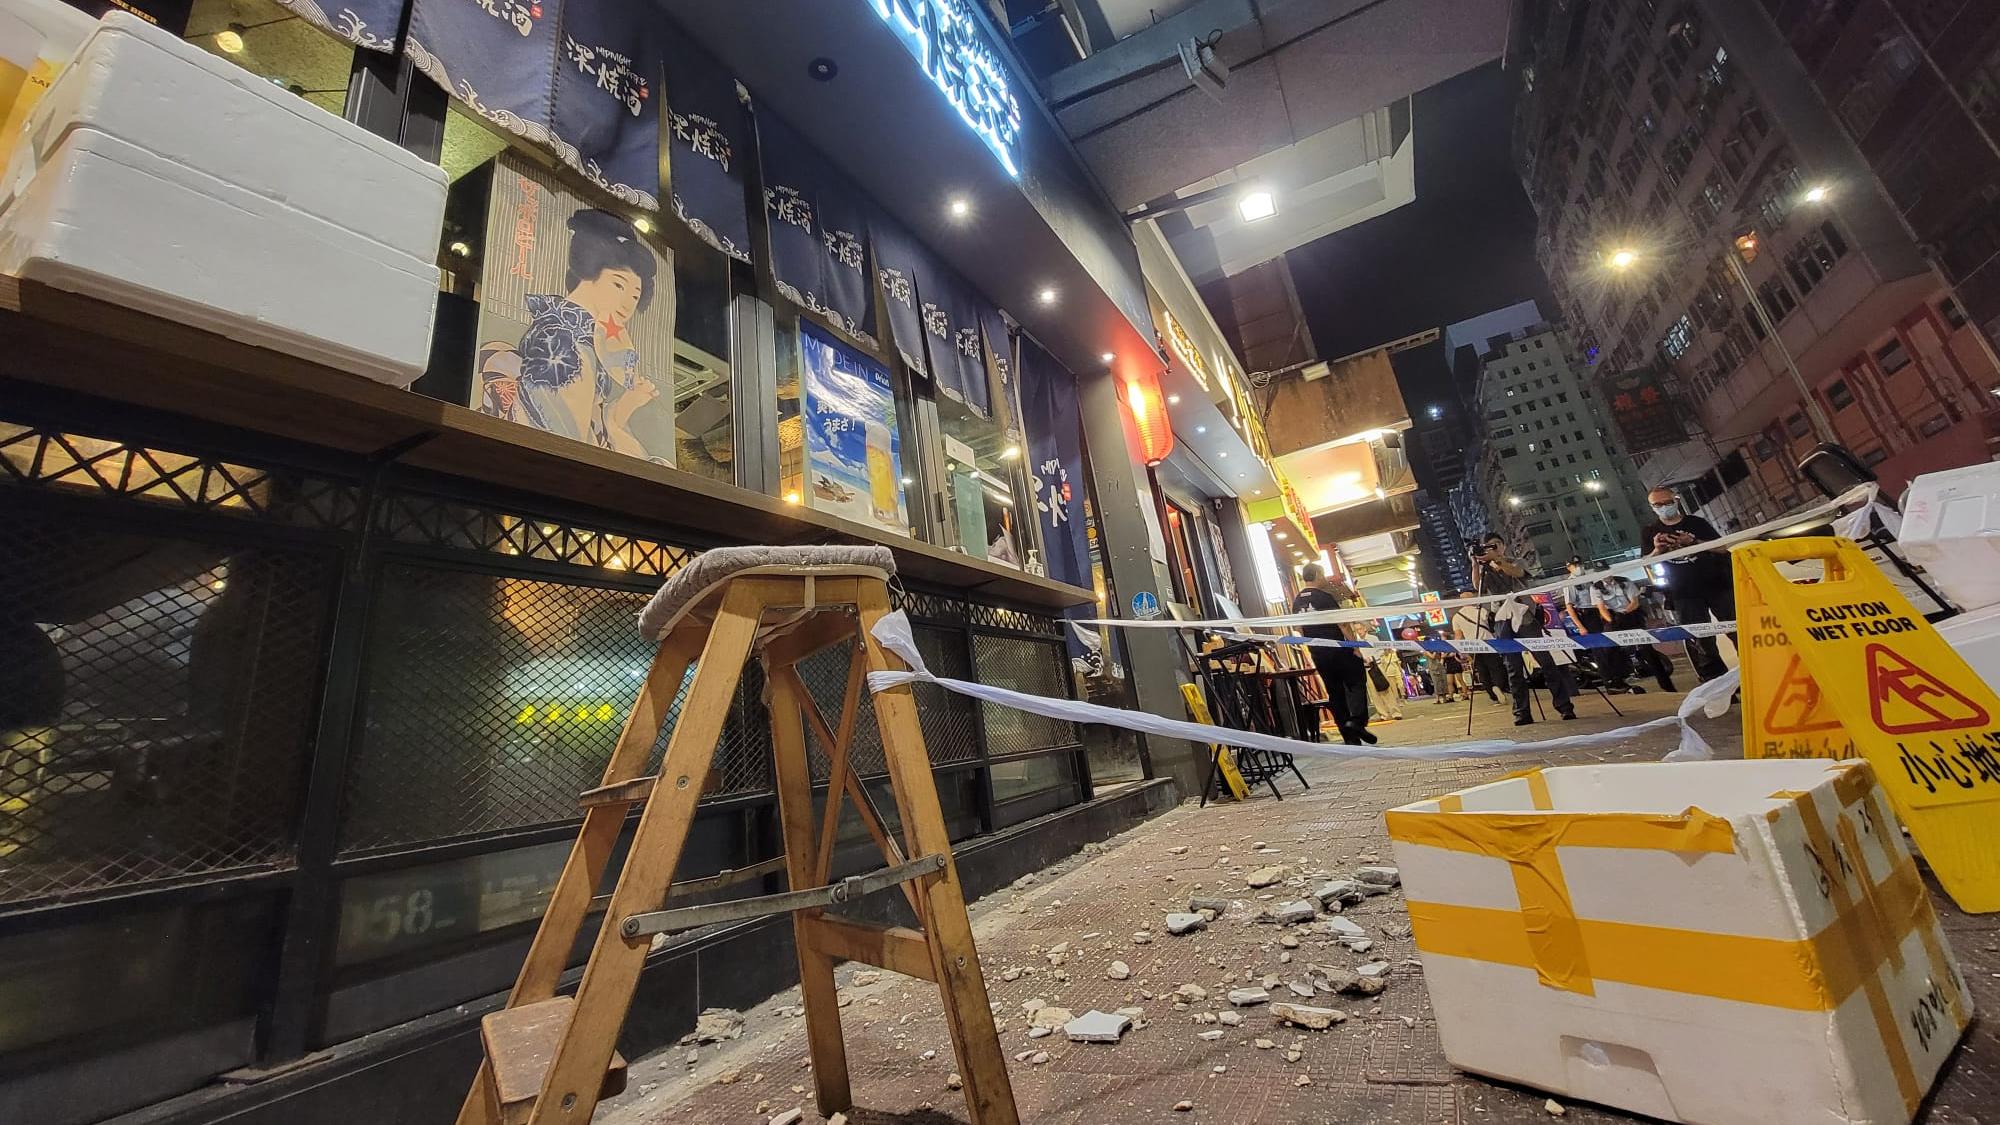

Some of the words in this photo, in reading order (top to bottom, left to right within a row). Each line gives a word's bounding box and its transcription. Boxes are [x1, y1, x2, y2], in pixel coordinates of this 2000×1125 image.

[804, 333, 850, 370] MDE
[1806, 601, 1892, 623] CAUTION
[1806, 624, 1850, 641] WET
[1854, 617, 1918, 637] FLOOR
